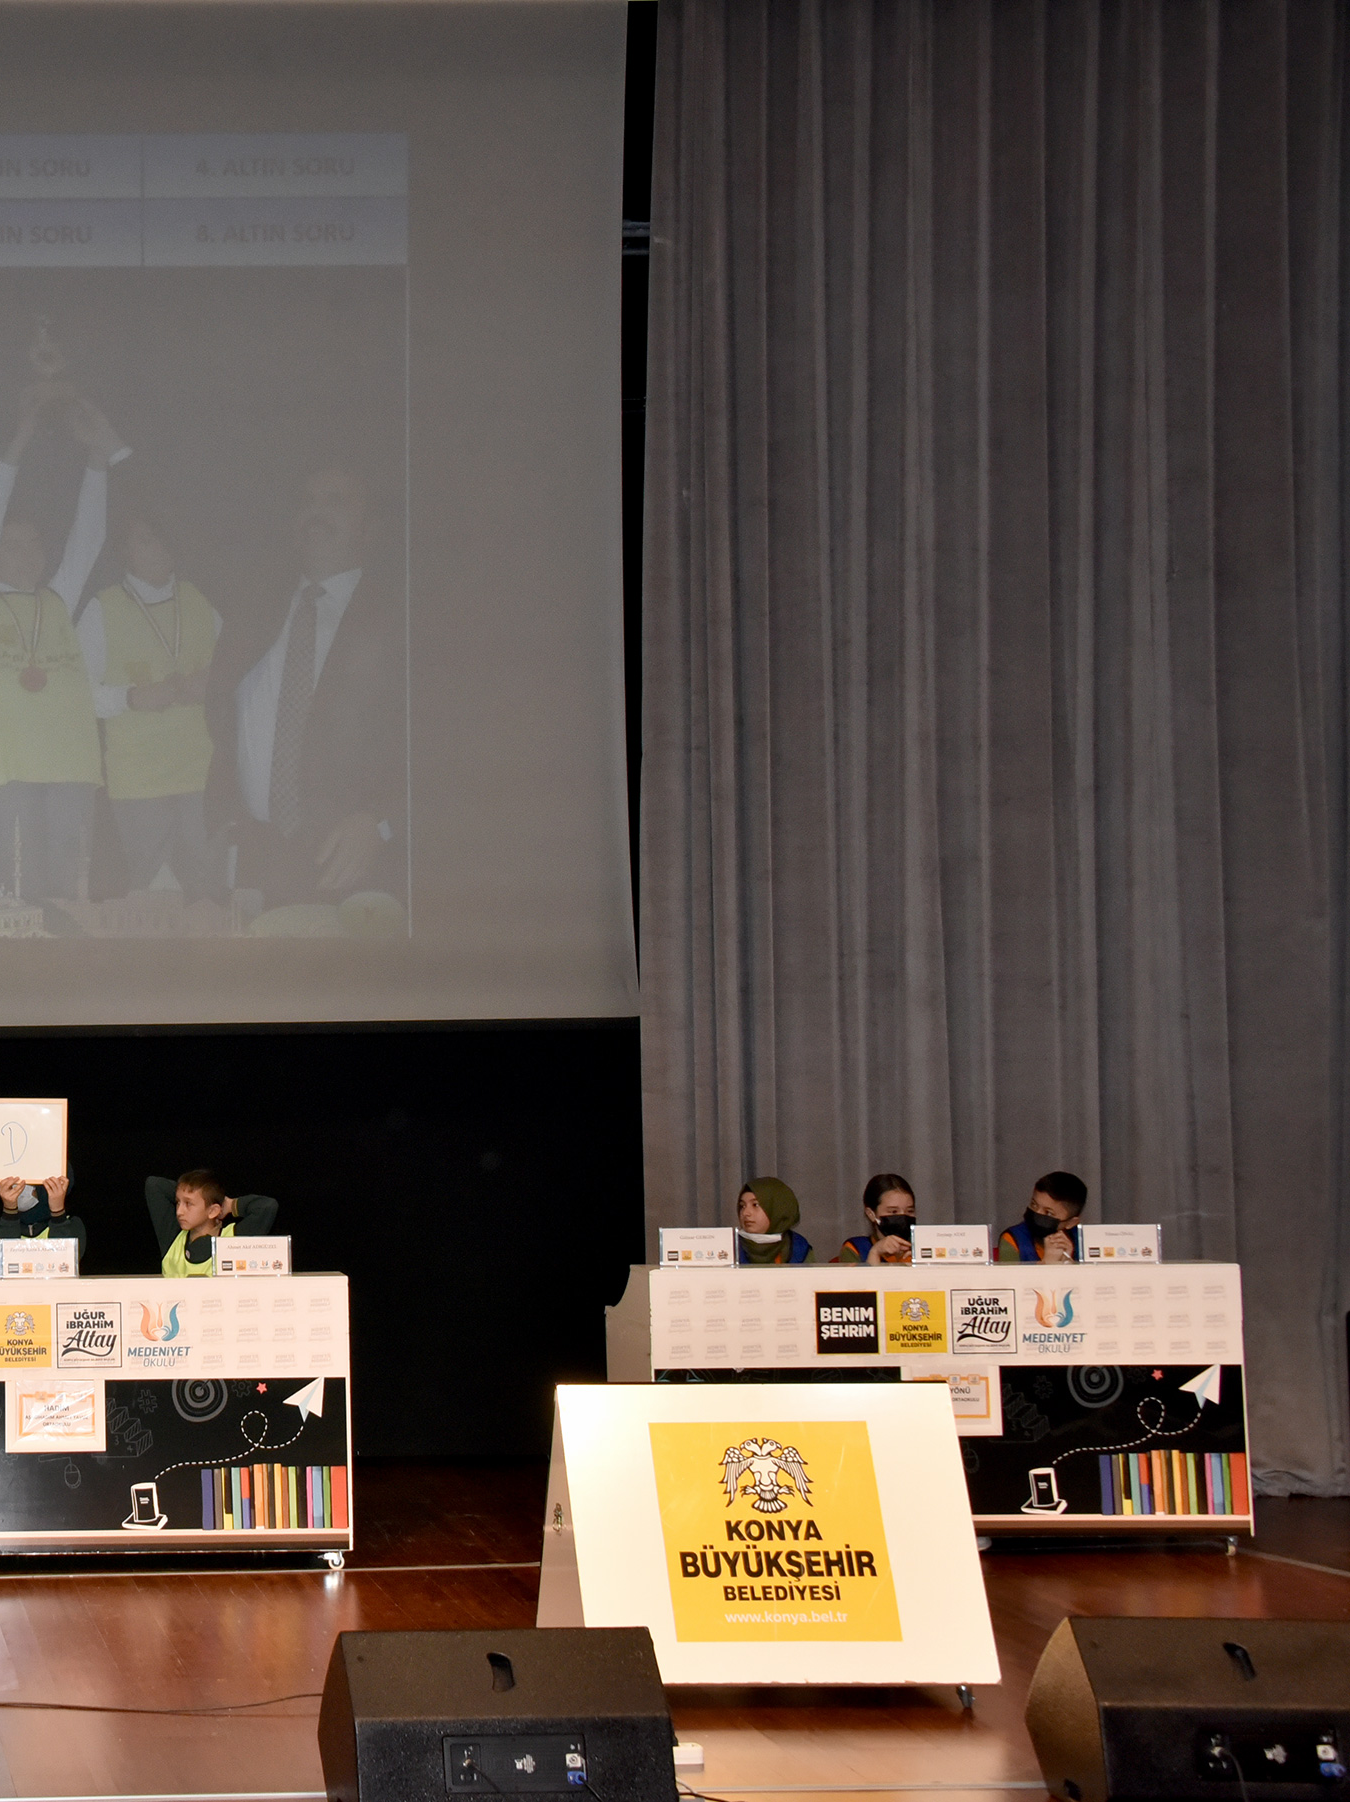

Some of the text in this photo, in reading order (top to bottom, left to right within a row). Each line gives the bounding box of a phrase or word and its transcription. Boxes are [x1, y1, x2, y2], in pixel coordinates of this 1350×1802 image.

[28, 159, 91, 178] SORU
[222, 158, 285, 177] ALTIN
[292, 157, 355, 177] SORU
[30, 225, 92, 245] SORU
[223, 225, 285, 244] ALTIN
[292, 224, 355, 244] SORU
[0, 1121, 28, 1167] D
[967, 1295, 1000, 1307] UĞUR
[73, 1309, 106, 1321] UĞUR
[902, 1324, 929, 1332] KONYA
[957, 1315, 1011, 1342] Altay
[62, 1329, 117, 1355] Altay
[1038, 1344, 1071, 1354] OKULU
[143, 1357, 176, 1368] OKULU
[725, 1519, 823, 1541] KONYA
[679, 1544, 877, 1581] BÜYÜKŞEHİR
[723, 1580, 841, 1601] BELEDİYESİ
[724, 1611, 848, 1626] www.konya.bel.tr
